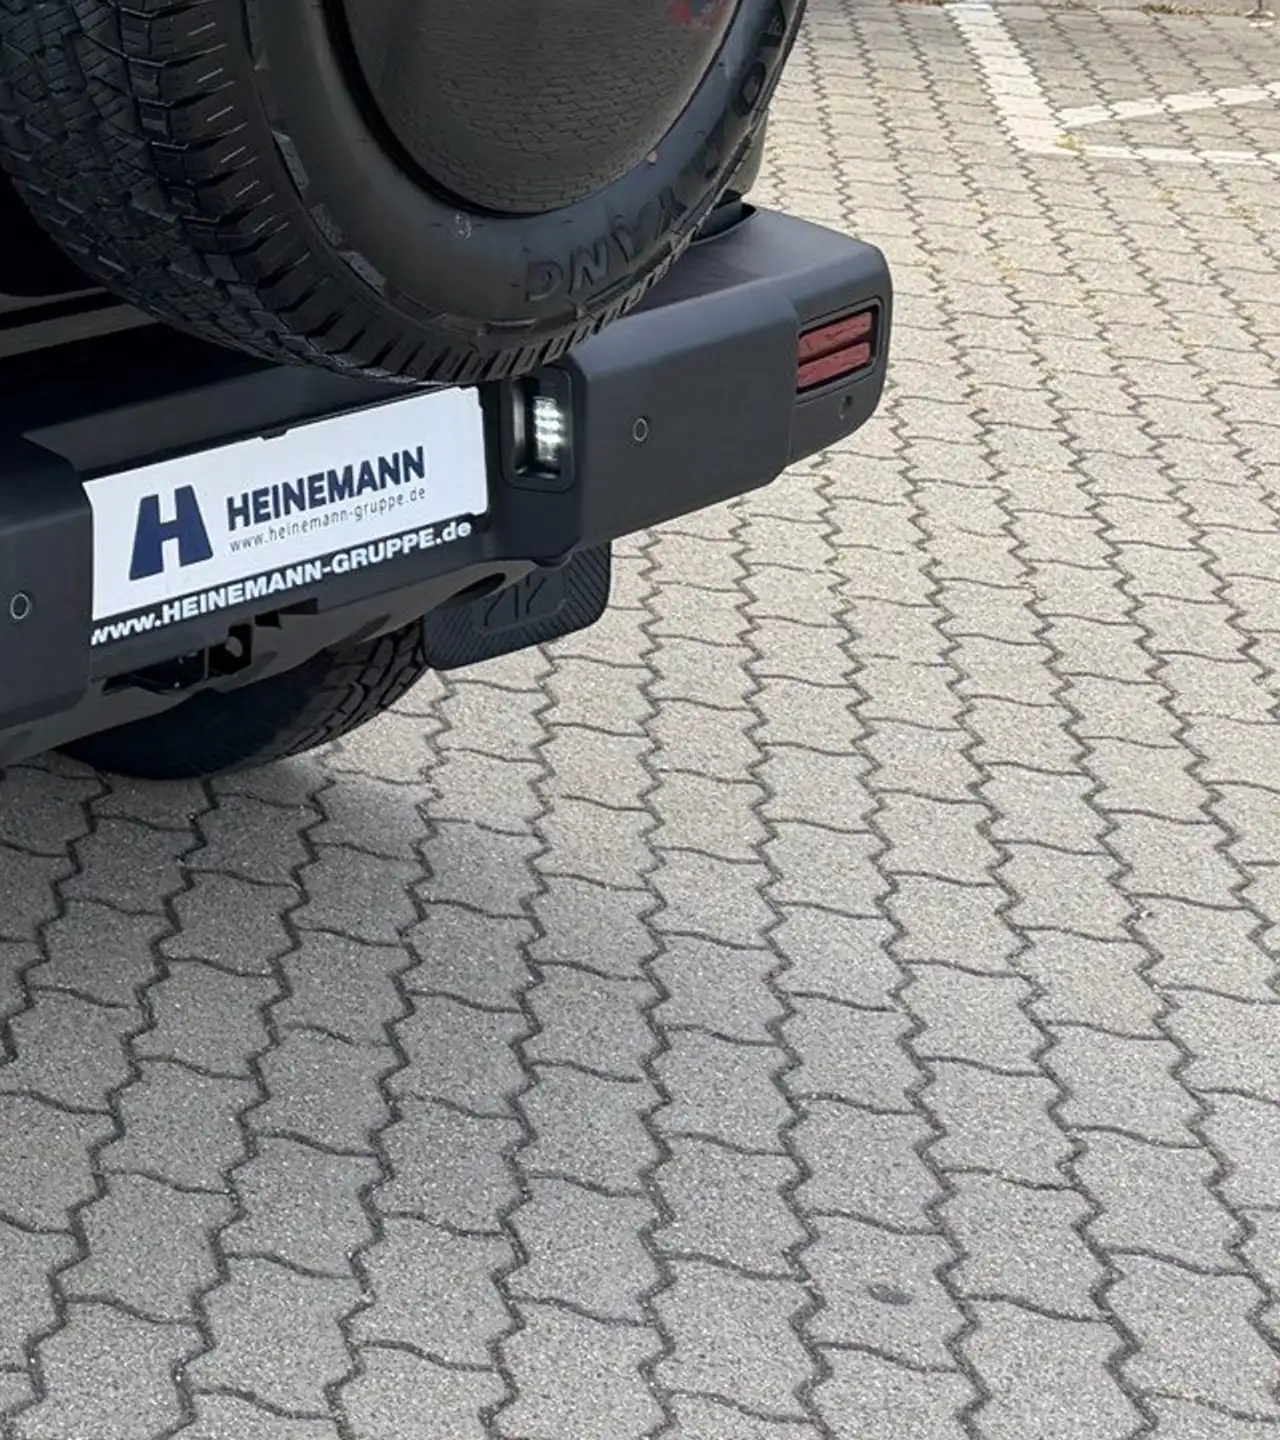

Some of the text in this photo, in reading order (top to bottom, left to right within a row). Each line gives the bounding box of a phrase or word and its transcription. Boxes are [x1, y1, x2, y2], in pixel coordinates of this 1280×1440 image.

[227, 446, 426, 532] HEINEMANN
[228, 486, 427, 552] www.heinemann-gruppe.de
[90, 520, 473, 646] www.HEINEMANN-GRUPPE.de
